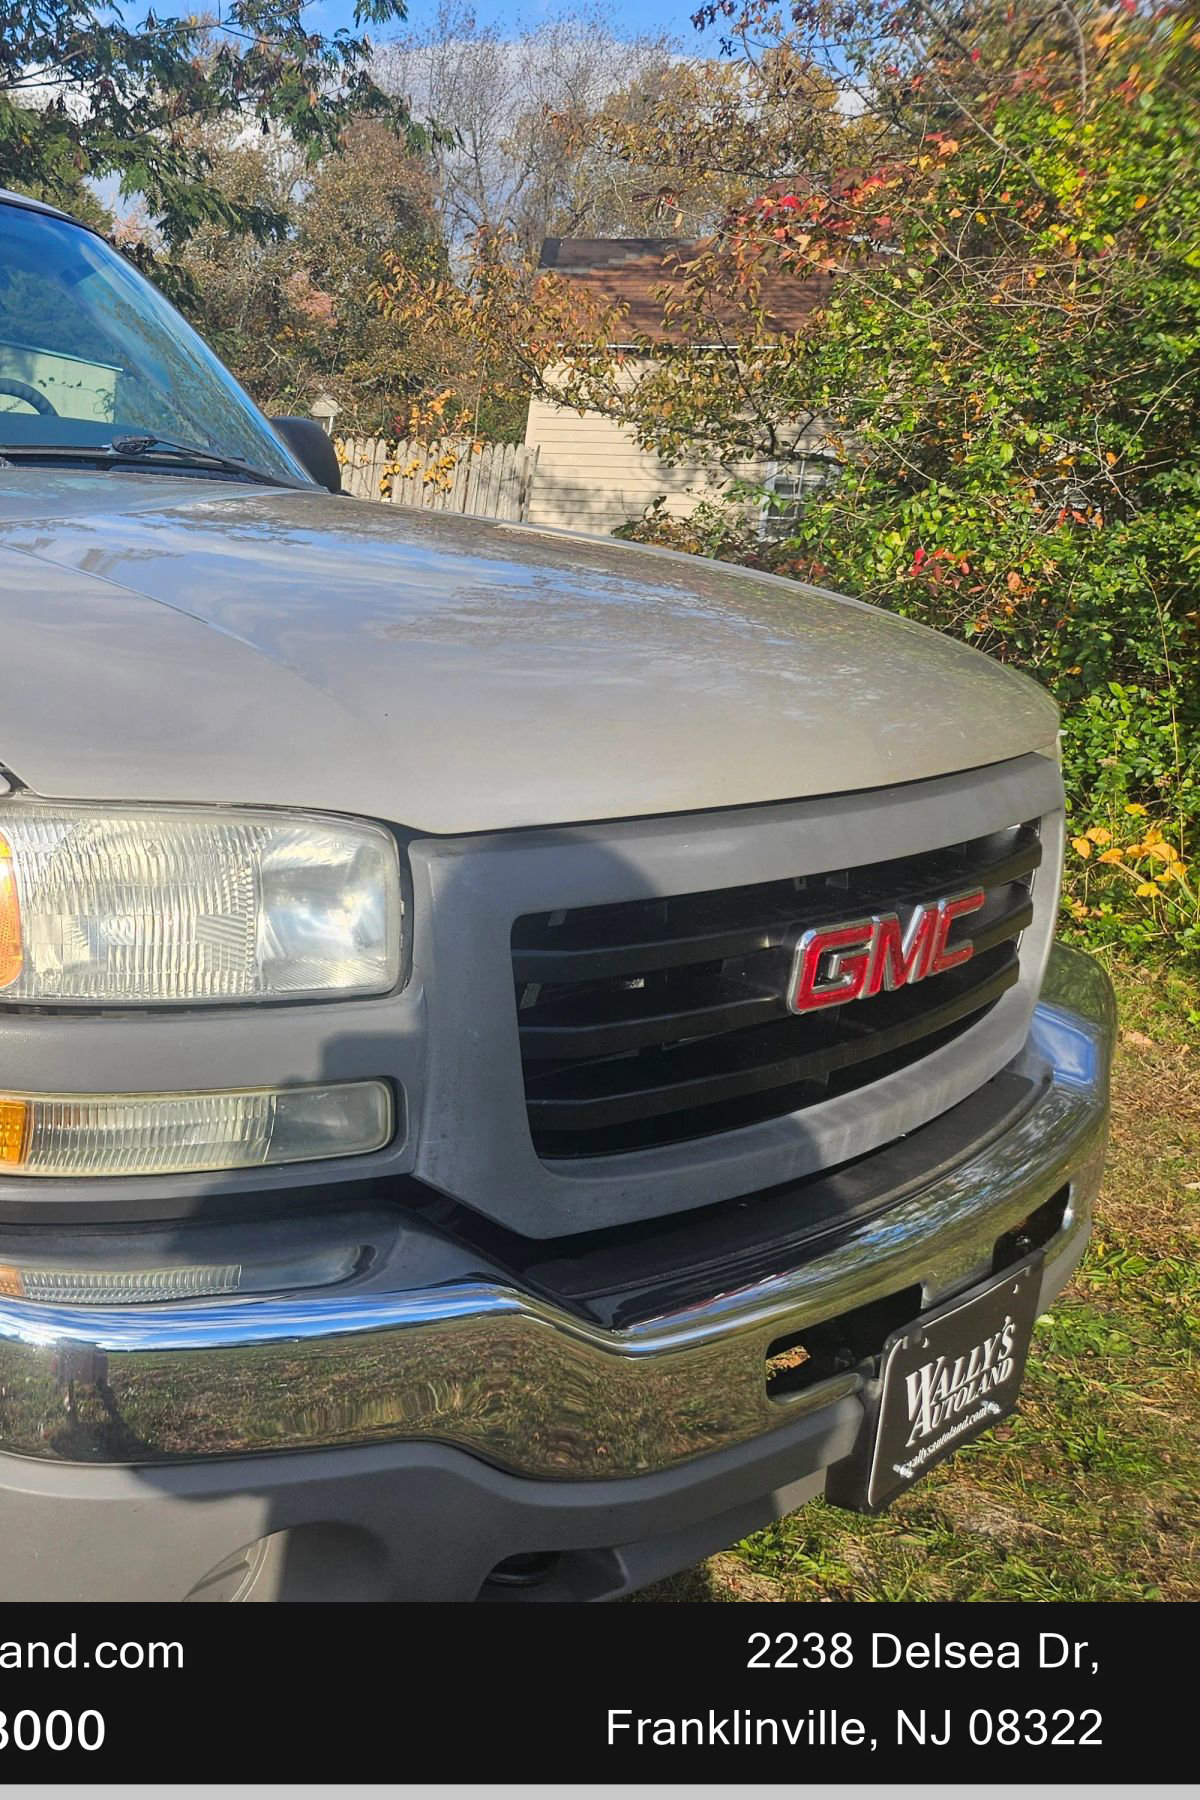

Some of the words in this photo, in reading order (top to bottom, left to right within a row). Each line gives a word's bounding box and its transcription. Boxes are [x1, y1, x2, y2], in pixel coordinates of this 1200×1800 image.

[786, 886, 986, 1015] GMC
[905, 1315, 1016, 1422] WALLY'S
[905, 1357, 1014, 1447] AUTOLAND
